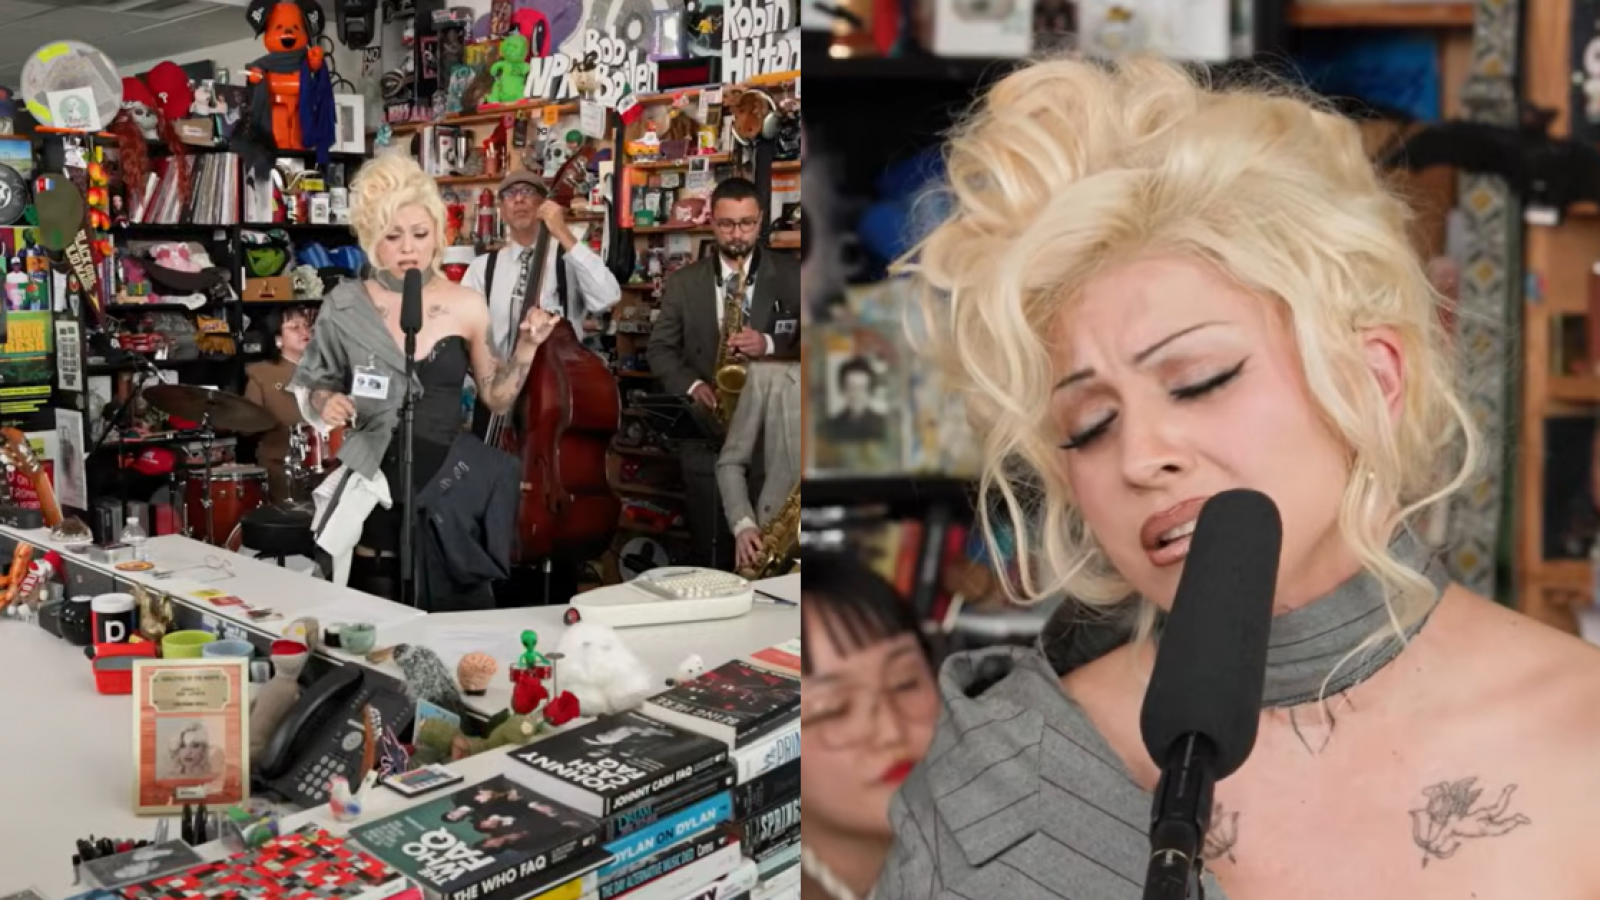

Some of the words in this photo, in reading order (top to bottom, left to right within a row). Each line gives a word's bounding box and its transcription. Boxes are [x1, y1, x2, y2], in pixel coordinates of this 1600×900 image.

[722, 0, 790, 39] Robin
[586, 26, 626, 66] Bob
[517, 751, 617, 791] JOHNNY
[567, 758, 630, 785] CASH
[597, 757, 647, 780] FAQ
[613, 783, 651, 809] JOHNNY
[652, 772, 676, 792] CASH
[676, 765, 693, 782] FAQ
[656, 828, 674, 845] ON
[675, 807, 717, 835] DYLAN
[402, 842, 464, 880] WHO
[420, 826, 497, 872] FAQ
[417, 868, 448, 886] THE
[453, 883, 479, 900] THE
[481, 868, 517, 894] WHO
[519, 855, 547, 877] FAQ
